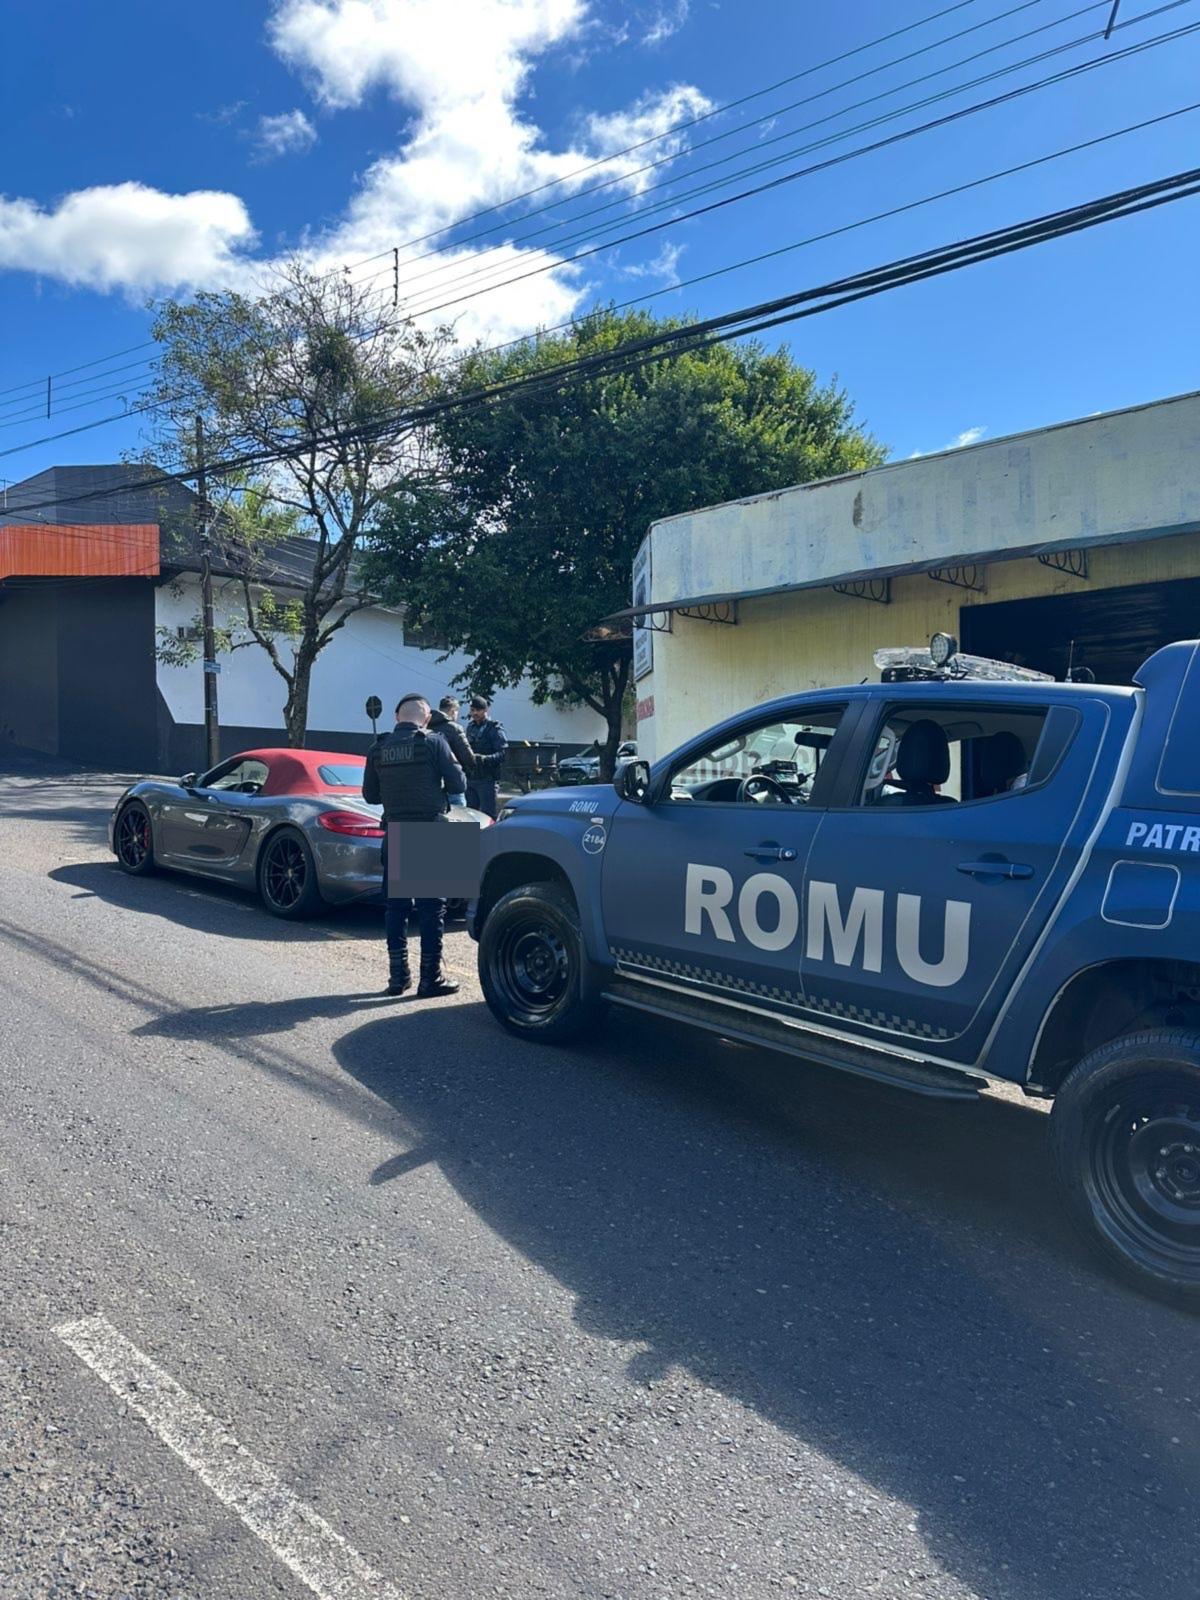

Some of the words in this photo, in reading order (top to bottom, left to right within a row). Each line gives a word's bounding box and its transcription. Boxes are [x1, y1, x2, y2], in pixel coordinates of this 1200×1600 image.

[382, 745, 412, 762] ROMU
[568, 800, 599, 813] ROMU
[1125, 821, 1200, 852] PATR
[685, 862, 972, 987] ROMU
